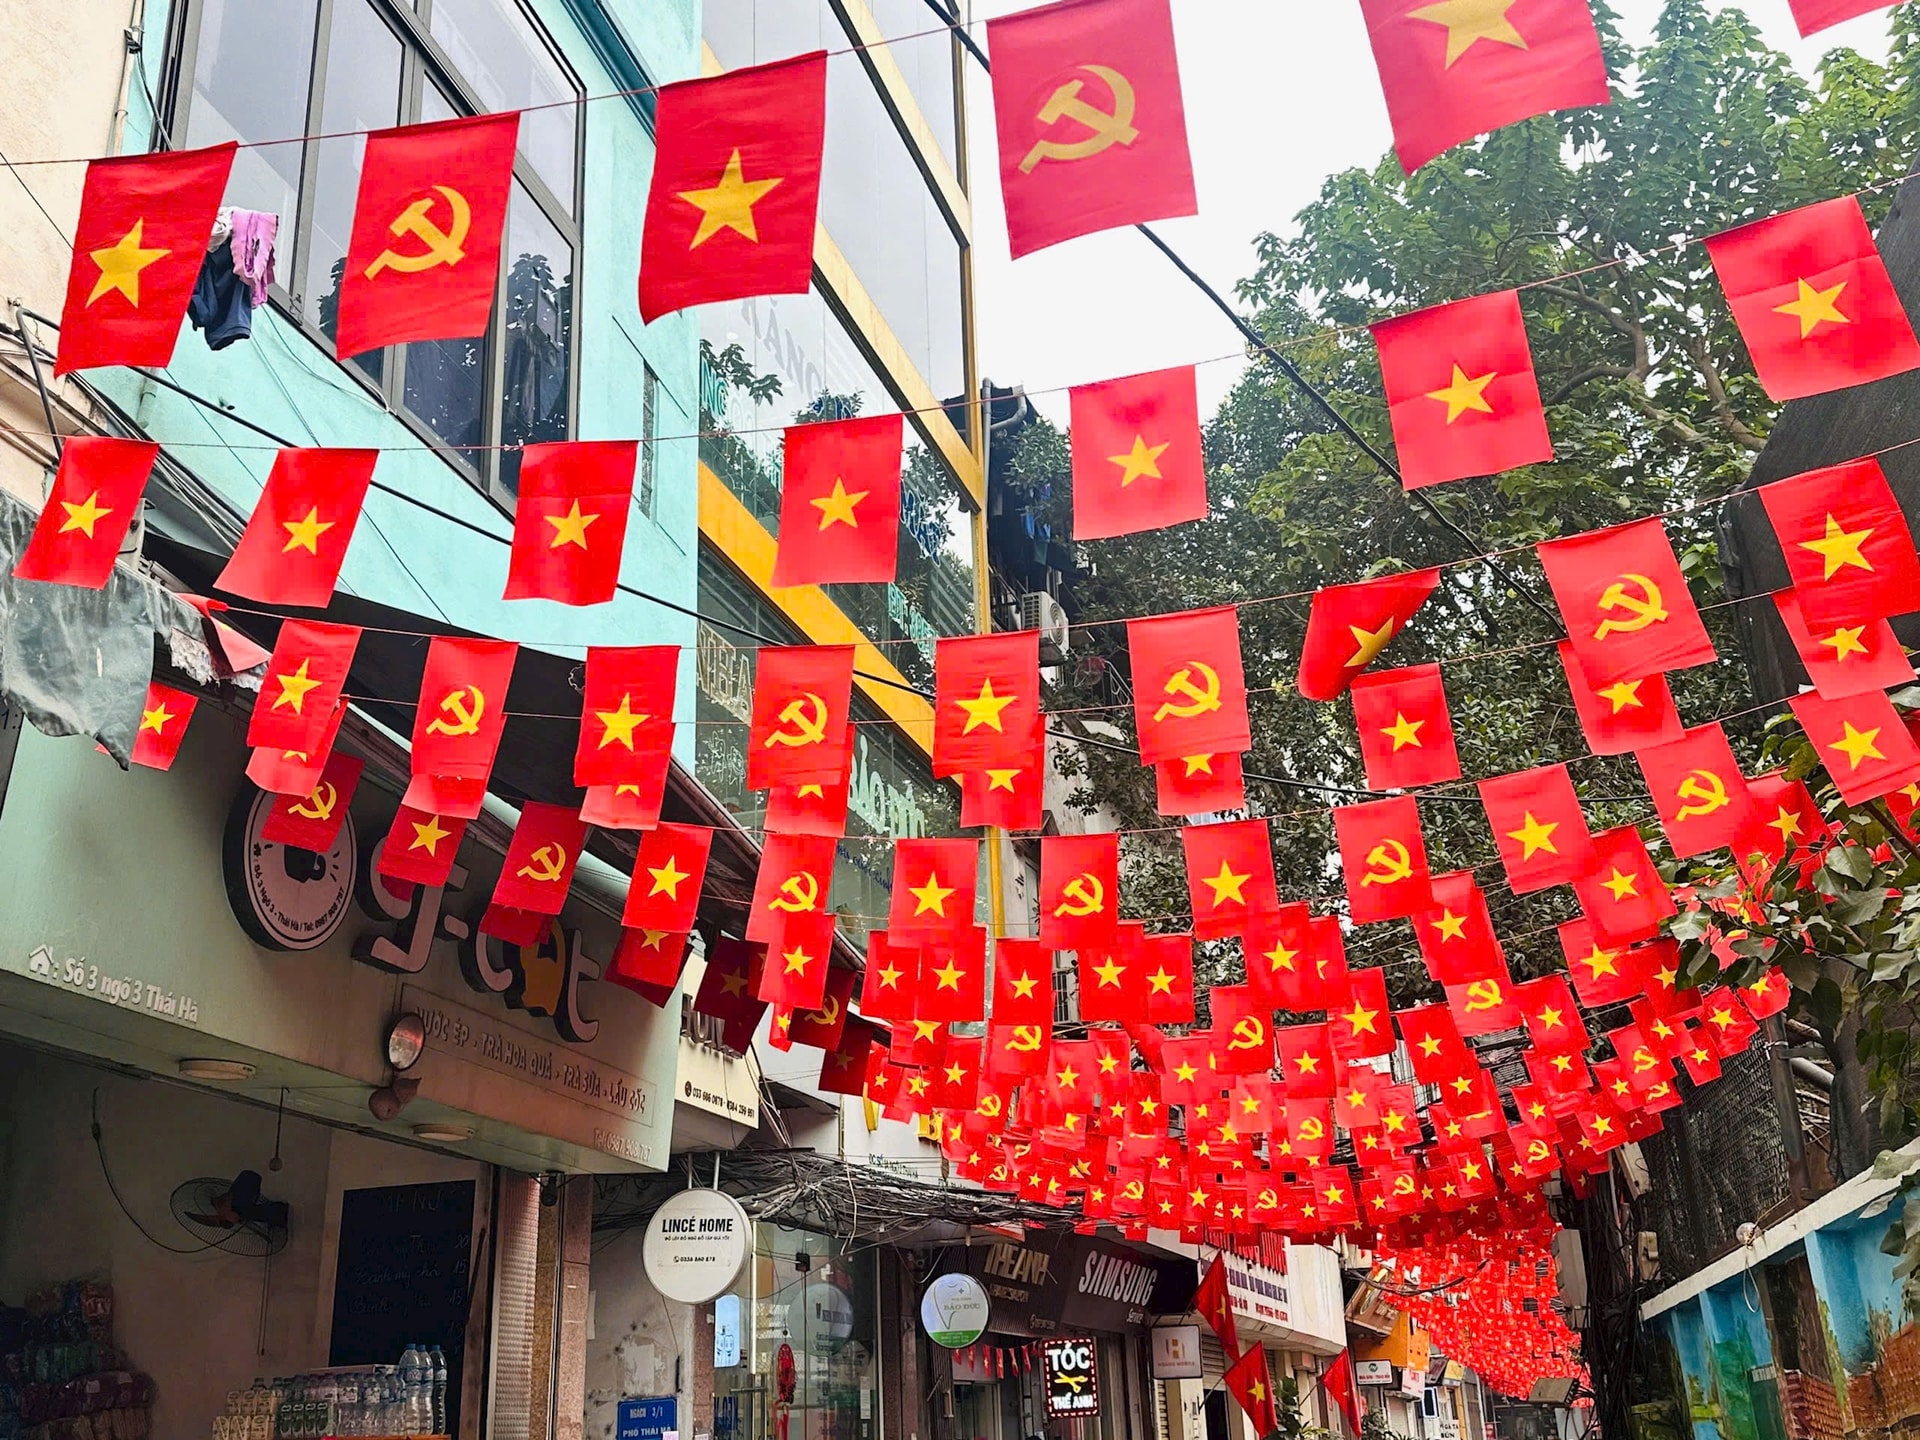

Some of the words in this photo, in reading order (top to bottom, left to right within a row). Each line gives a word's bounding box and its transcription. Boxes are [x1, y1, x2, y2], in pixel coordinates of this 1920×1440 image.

[63, 957, 86, 986] Số
[87, 965, 98, 990] 3
[101, 976, 132, 1004] ngõ
[132, 980, 143, 1003] 3
[146, 984, 175, 1016] Thái
[178, 995, 198, 1023] Hà
[453, 1018, 470, 1047] ÉP
[482, 1032, 502, 1062] TRÀ
[505, 1043, 526, 1070] HOA
[563, 1064, 581, 1090] TRÀ
[662, 1216, 696, 1232] LINCÉ
[699, 1218, 734, 1232] HOME
[1078, 1250, 1158, 1307] SAMSUNG
[1047, 1341, 1090, 1371] TÓC
[1072, 1395, 1093, 1408] ANH
[641, 1425, 659, 1437] THÁI
